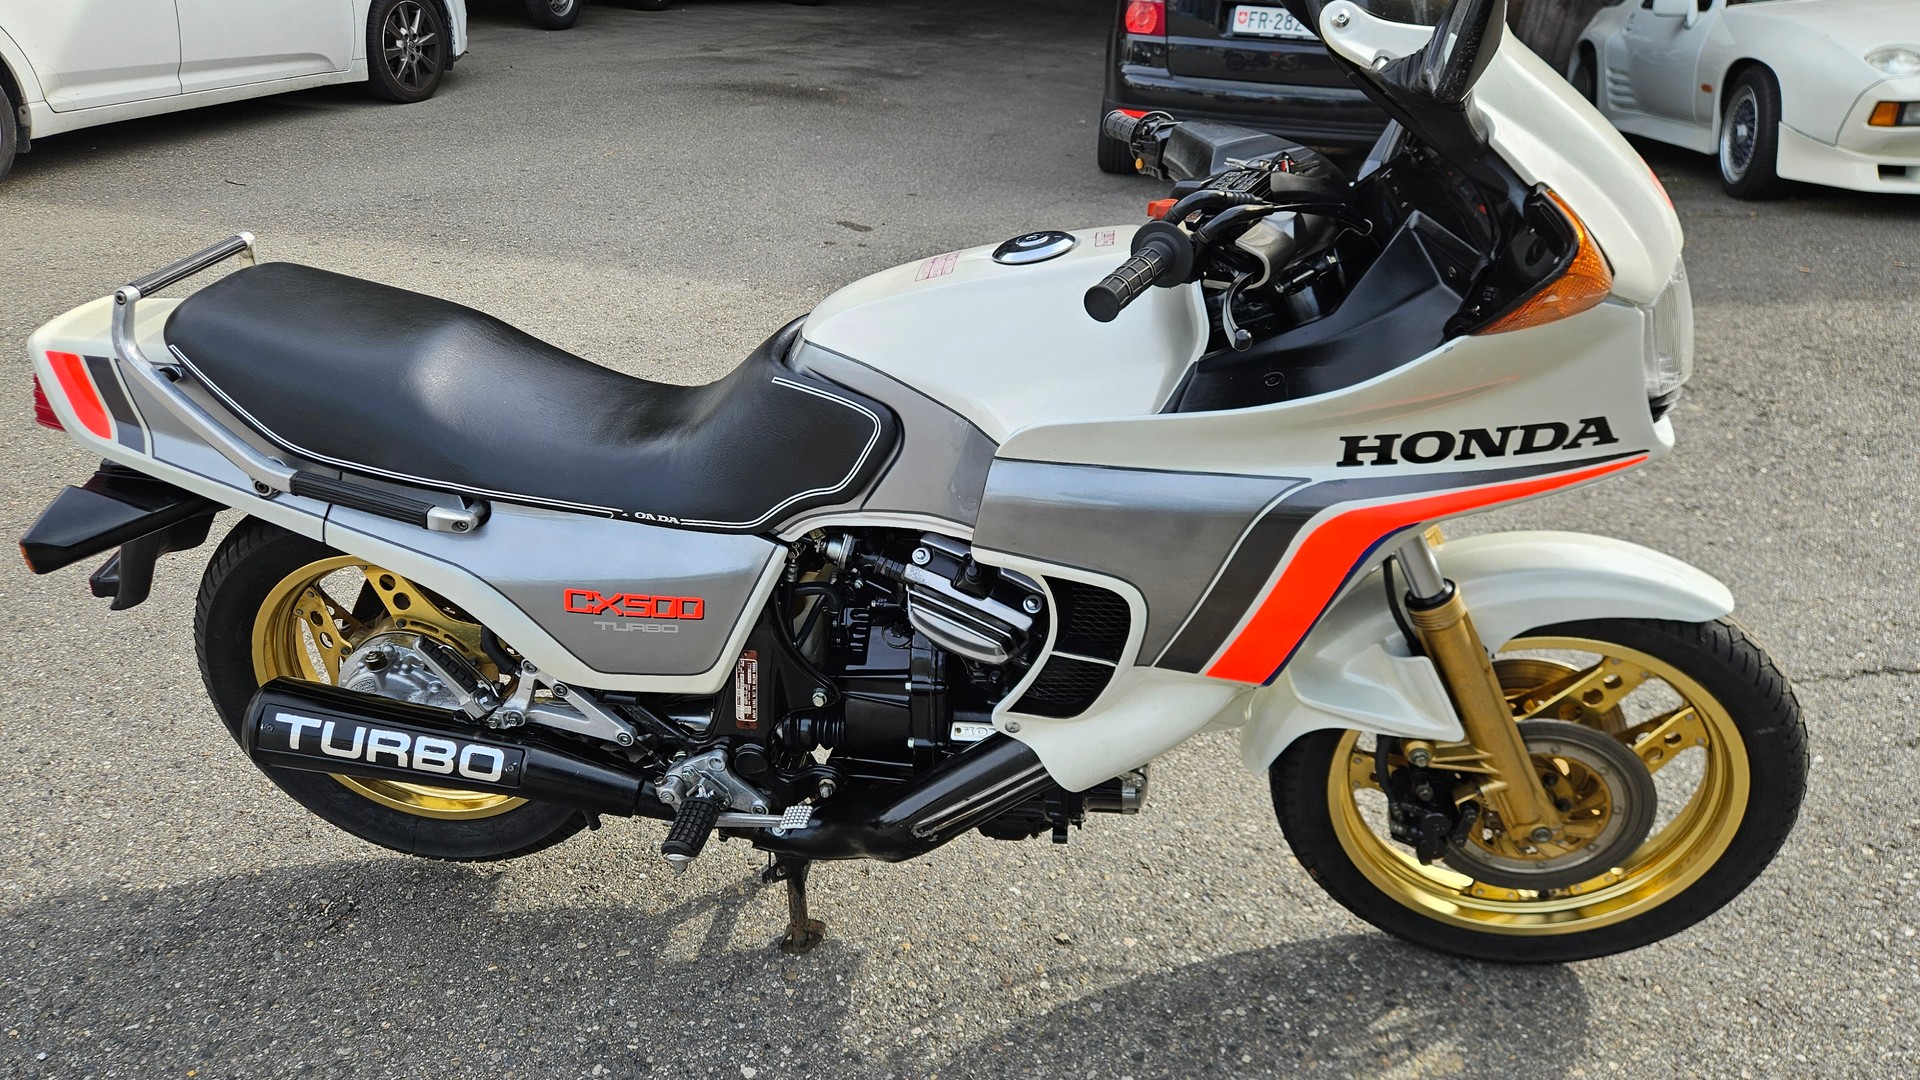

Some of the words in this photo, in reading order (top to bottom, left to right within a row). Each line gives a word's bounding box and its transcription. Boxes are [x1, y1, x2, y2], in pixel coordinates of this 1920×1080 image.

[1336, 416, 1619, 467] HONDA
[622, 511, 681, 524] ONDA
[563, 588, 704, 619] CX500
[593, 621, 679, 633] TURBO
[275, 712, 504, 782] TURBO
